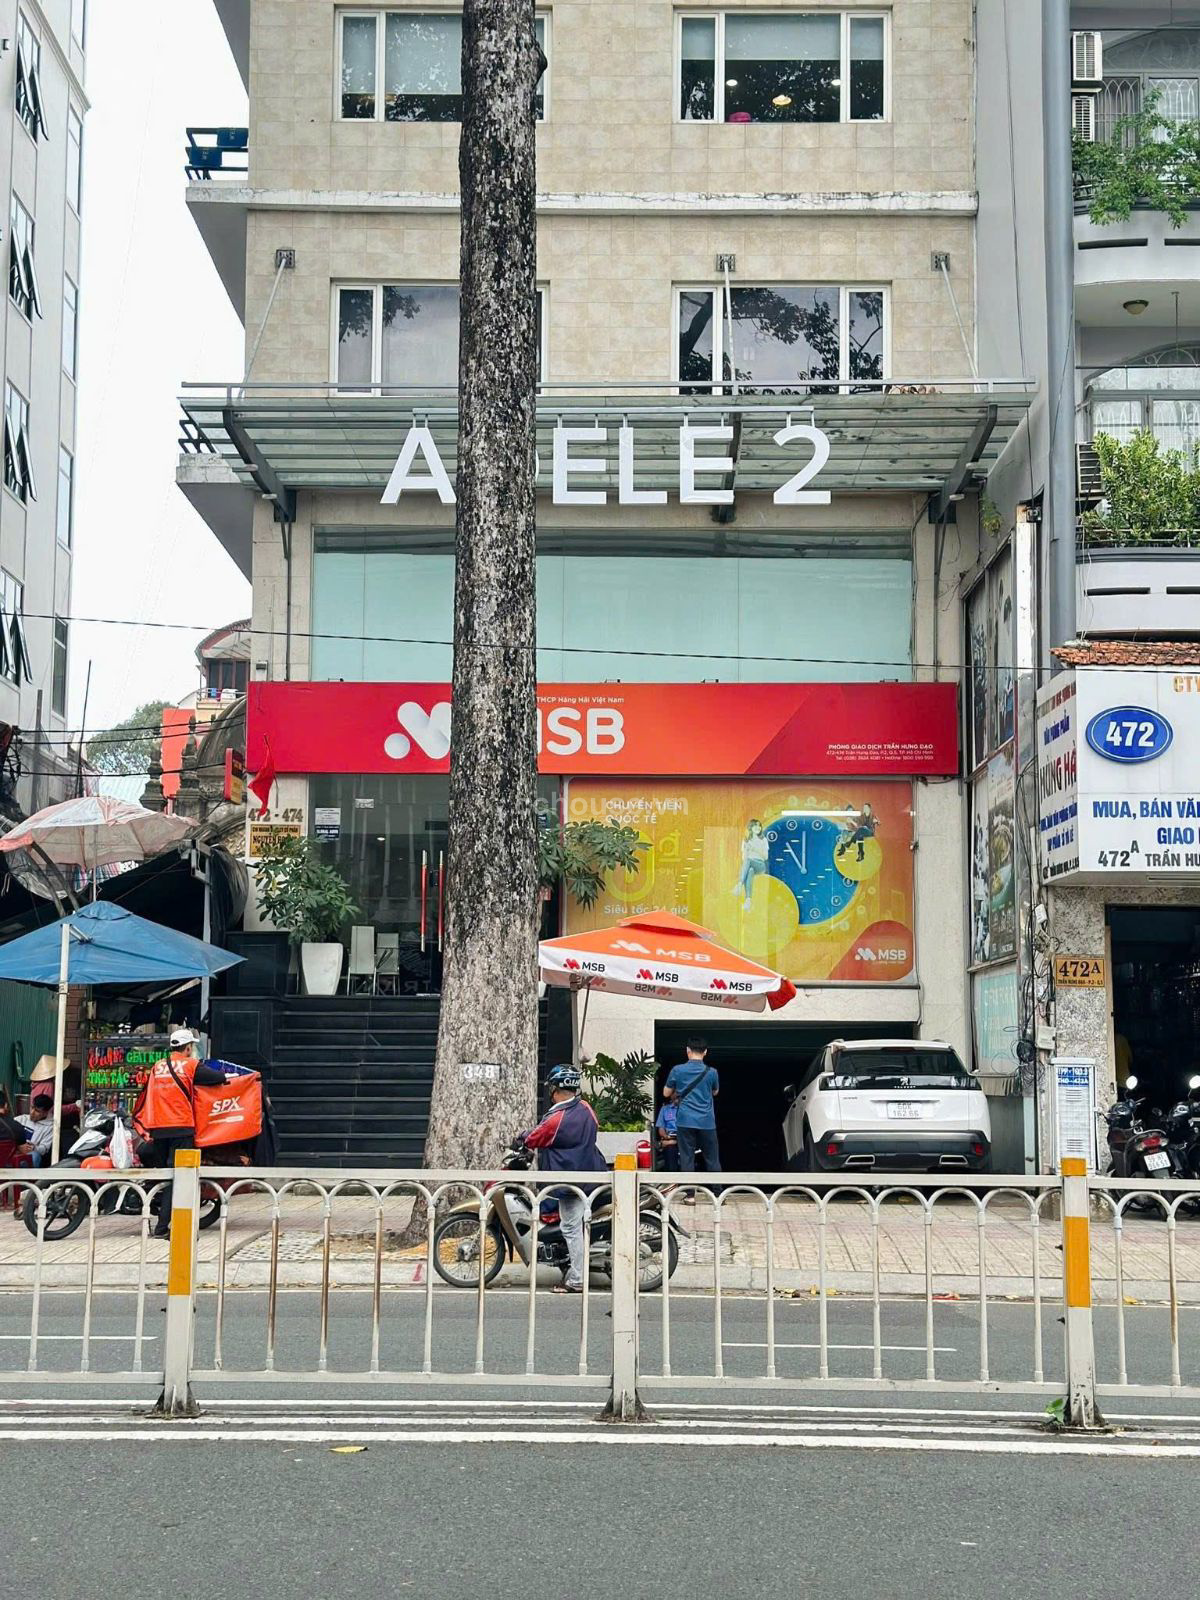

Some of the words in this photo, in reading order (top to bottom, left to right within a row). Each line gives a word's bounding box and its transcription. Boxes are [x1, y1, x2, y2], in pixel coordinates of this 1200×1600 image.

[379, 427, 735, 504] AELE
[773, 424, 832, 504] 2
[1105, 721, 1155, 747] 472
[282, 807, 304, 822] 474
[1092, 800, 1137, 820] MUA,
[1139, 797, 1173, 818] BÁN
[1157, 826, 1195, 845] GIAO
[1145, 848, 1181, 867] TRẦN
[656, 948, 712, 963] MSB
[878, 949, 907, 961] MSB
[581, 961, 606, 973] MSB
[1058, 960, 1101, 978] 472A
[655, 971, 679, 983] MSB
[729, 981, 753, 992] MSB
[211, 1096, 242, 1113] SPX
